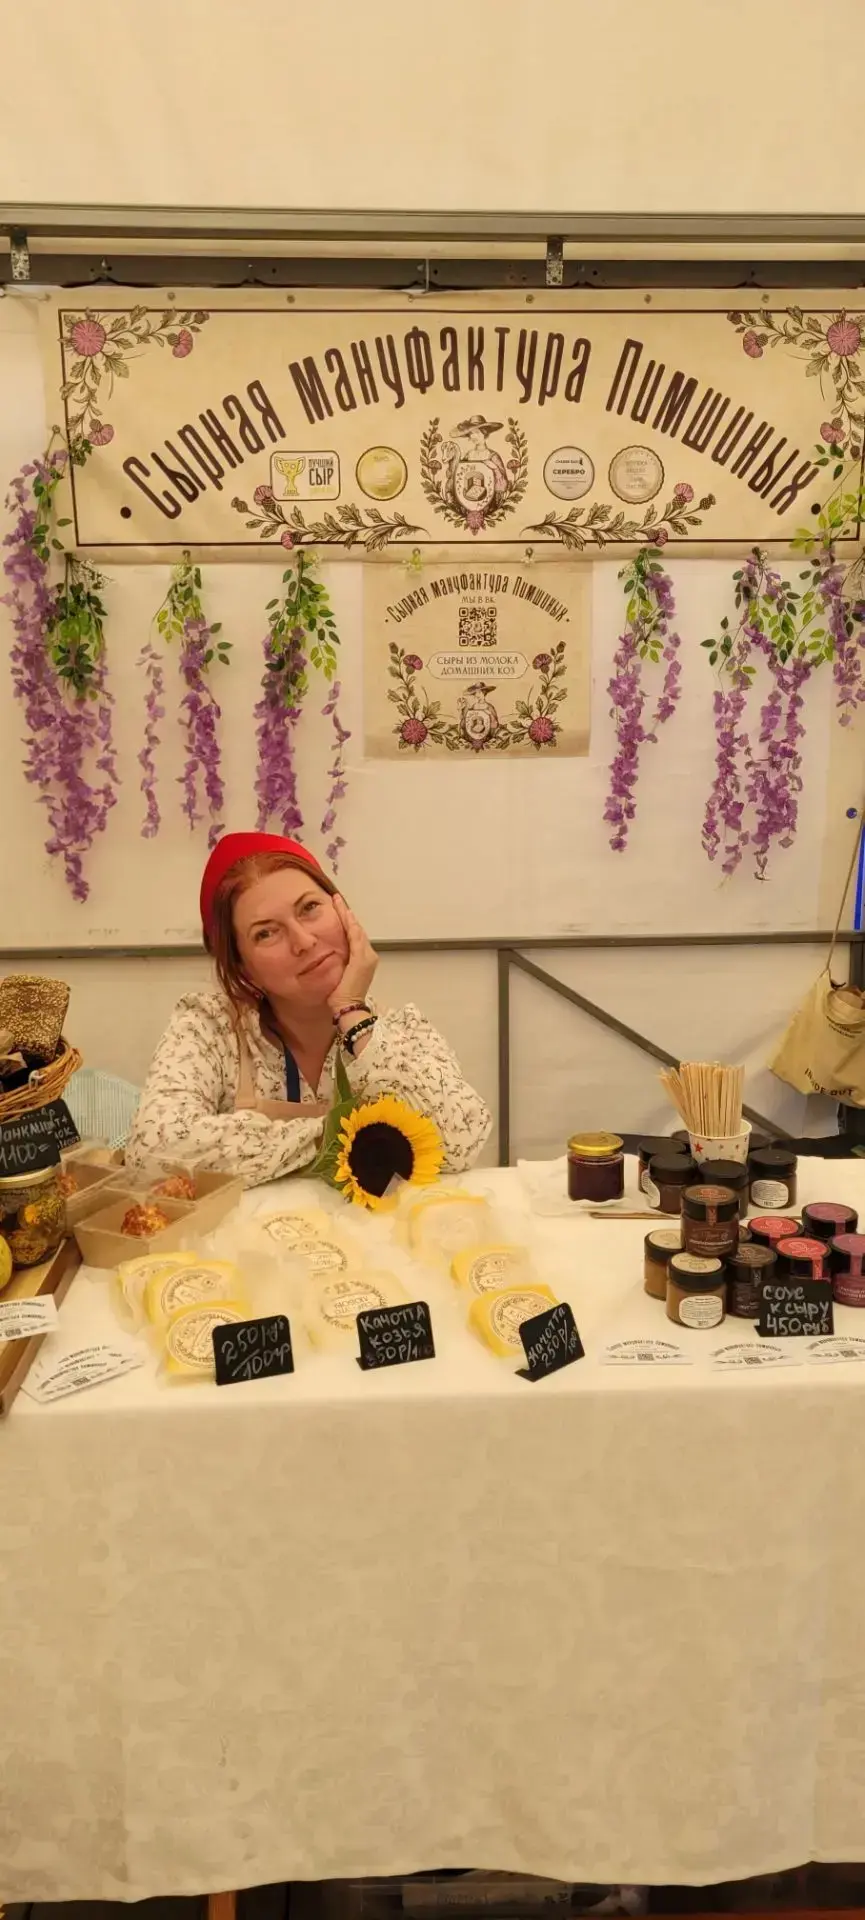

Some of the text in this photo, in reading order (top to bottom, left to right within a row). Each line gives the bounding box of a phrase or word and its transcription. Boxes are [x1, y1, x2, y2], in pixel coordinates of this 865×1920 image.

[121, 379, 287, 520] Сырная
[604, 338, 820, 516] Пимшиных
[309, 468, 334, 486] СЫР
[386, 586, 430, 623] Сырная
[511, 576, 569, 622] Пимшиных
[461, 596, 476, 604] МЫ
[436, 656, 519, 665] СЫРЫ ИЗ МОЛОКА
[440, 666, 515, 676] ДОМАШНИХ КОЗ
